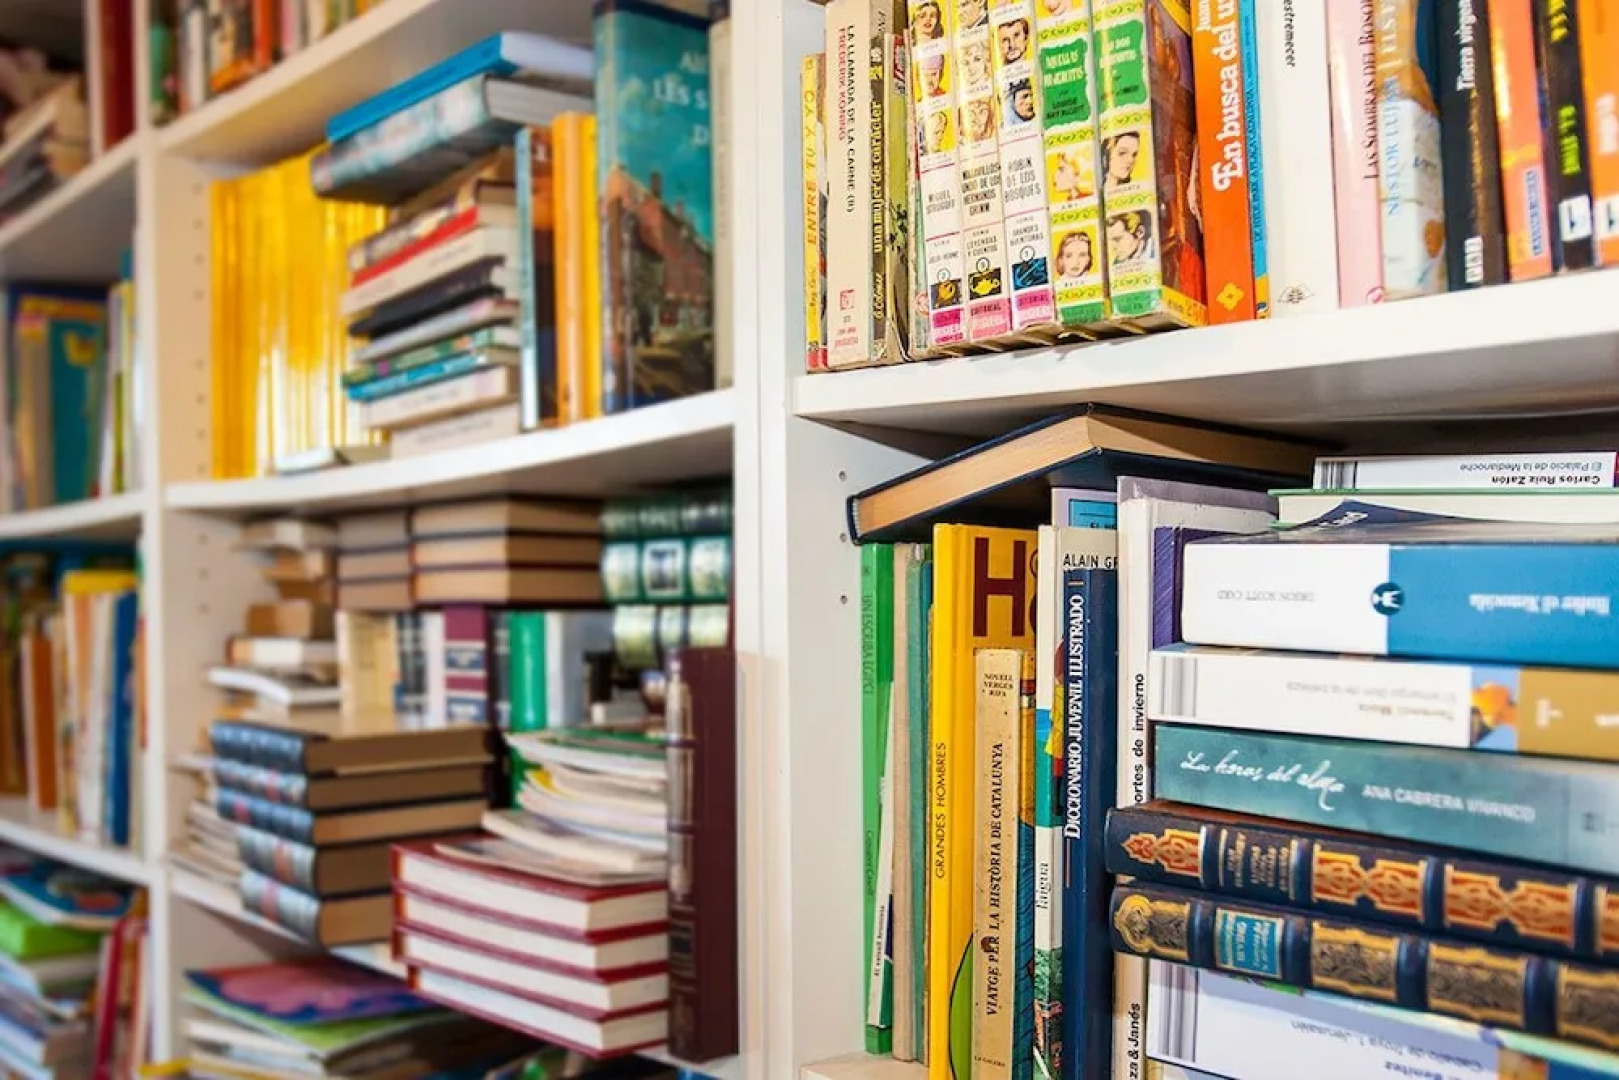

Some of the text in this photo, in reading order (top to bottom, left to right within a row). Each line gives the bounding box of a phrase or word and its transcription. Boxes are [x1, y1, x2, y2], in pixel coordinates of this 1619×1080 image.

[1212, 21, 1237, 61] del
[847, 44, 855, 105] LLAMADA
[847, 108, 855, 125] DE
[1216, 67, 1242, 141] busca
[847, 129, 855, 144] LA
[847, 148, 855, 192] CARNE
[1211, 143, 1243, 191] En
[805, 181, 818, 245] ENTRE
[875, 187, 884, 223] mujer
[875, 225, 883, 252] una
[1460, 461, 1603, 472] El Palacio de la Medianoche
[1530, 475, 1556, 485] Ruiz
[1560, 475, 1601, 485] Carlos
[1063, 553, 1099, 568] ALAIN
[1064, 595, 1084, 839] DICCIONARIO JUVENIL ILUSTRADO
[1131, 673, 1145, 731] invierno
[1131, 735, 1144, 758] de
[990, 743, 1003, 818] CATALUNYA
[934, 743, 947, 880] GRANDES HOMBRES
[990, 820, 1002, 839] DE
[988, 912, 1000, 931] LA
[987, 936, 1000, 964] PER
[986, 967, 1000, 1016] VIATGE
[1127, 1049, 1139, 1059] &
